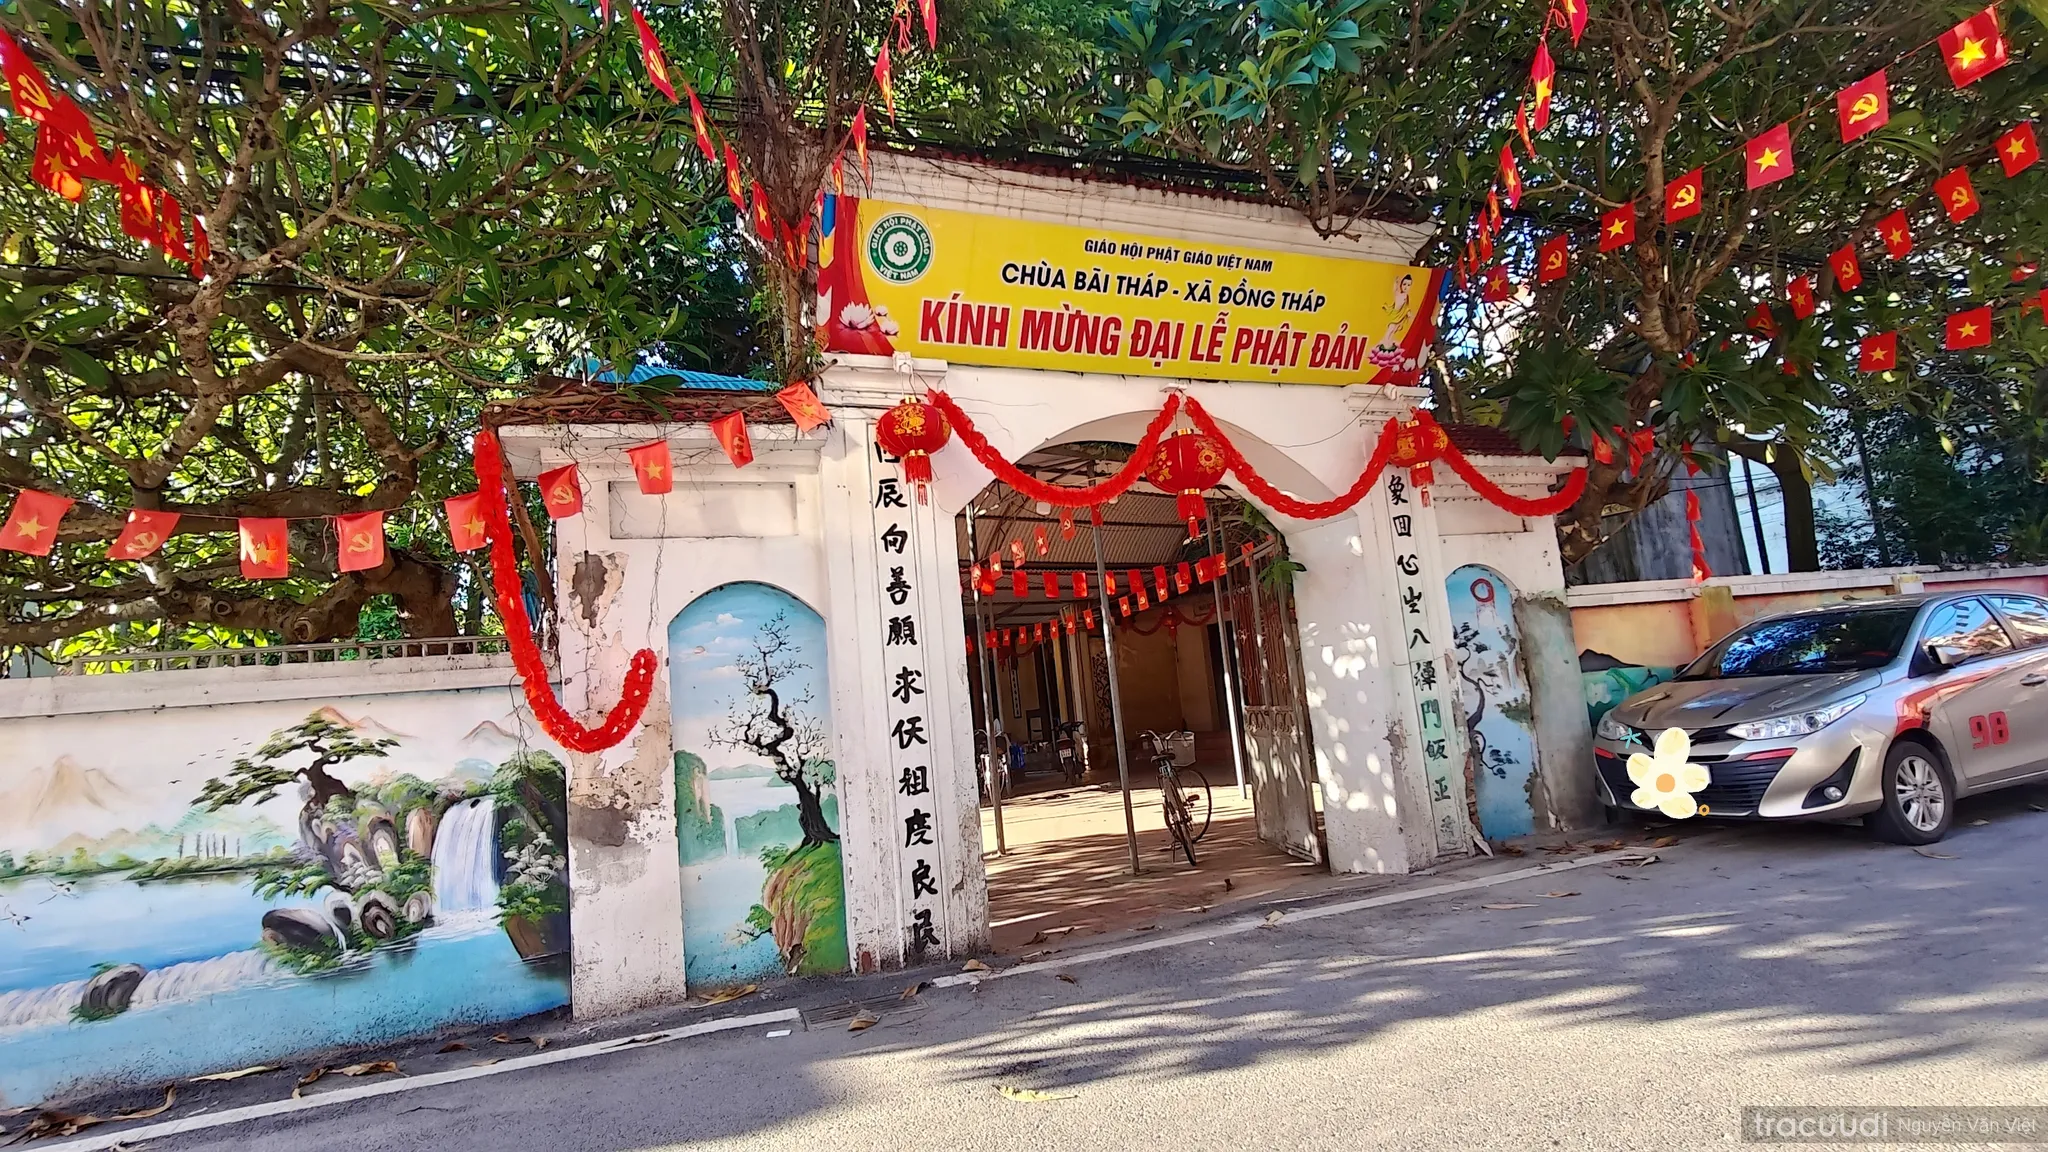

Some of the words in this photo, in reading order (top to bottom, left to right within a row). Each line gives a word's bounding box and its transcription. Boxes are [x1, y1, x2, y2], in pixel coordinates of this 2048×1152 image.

[900, 268, 918, 280] NAM
[1084, 239, 1116, 254] GIÁO
[1120, 242, 1142, 260] HỘI
[1146, 247, 1180, 264] PHẬT
[1184, 250, 1212, 266] GIÁO
[1217, 254, 1242, 270] VIỆT
[1244, 258, 1272, 272] NAM
[1002, 260, 1066, 289] CHÙA
[1074, 268, 1110, 294] BÃI
[1116, 272, 1168, 298] THÁP
[1184, 280, 1212, 303] XÃ
[1218, 278, 1276, 308] ĐỒNG
[1281, 288, 1326, 312] THÁP
[920, 292, 1010, 348] KÍNH
[1019, 304, 1122, 356] MỪNG
[1129, 318, 1184, 368] ĐẠI
[1190, 311, 1228, 363] LỄ
[1231, 322, 1307, 374] PHẬT
[1310, 322, 1367, 371] ĐẢN
[1969, 711, 2009, 749] 98
